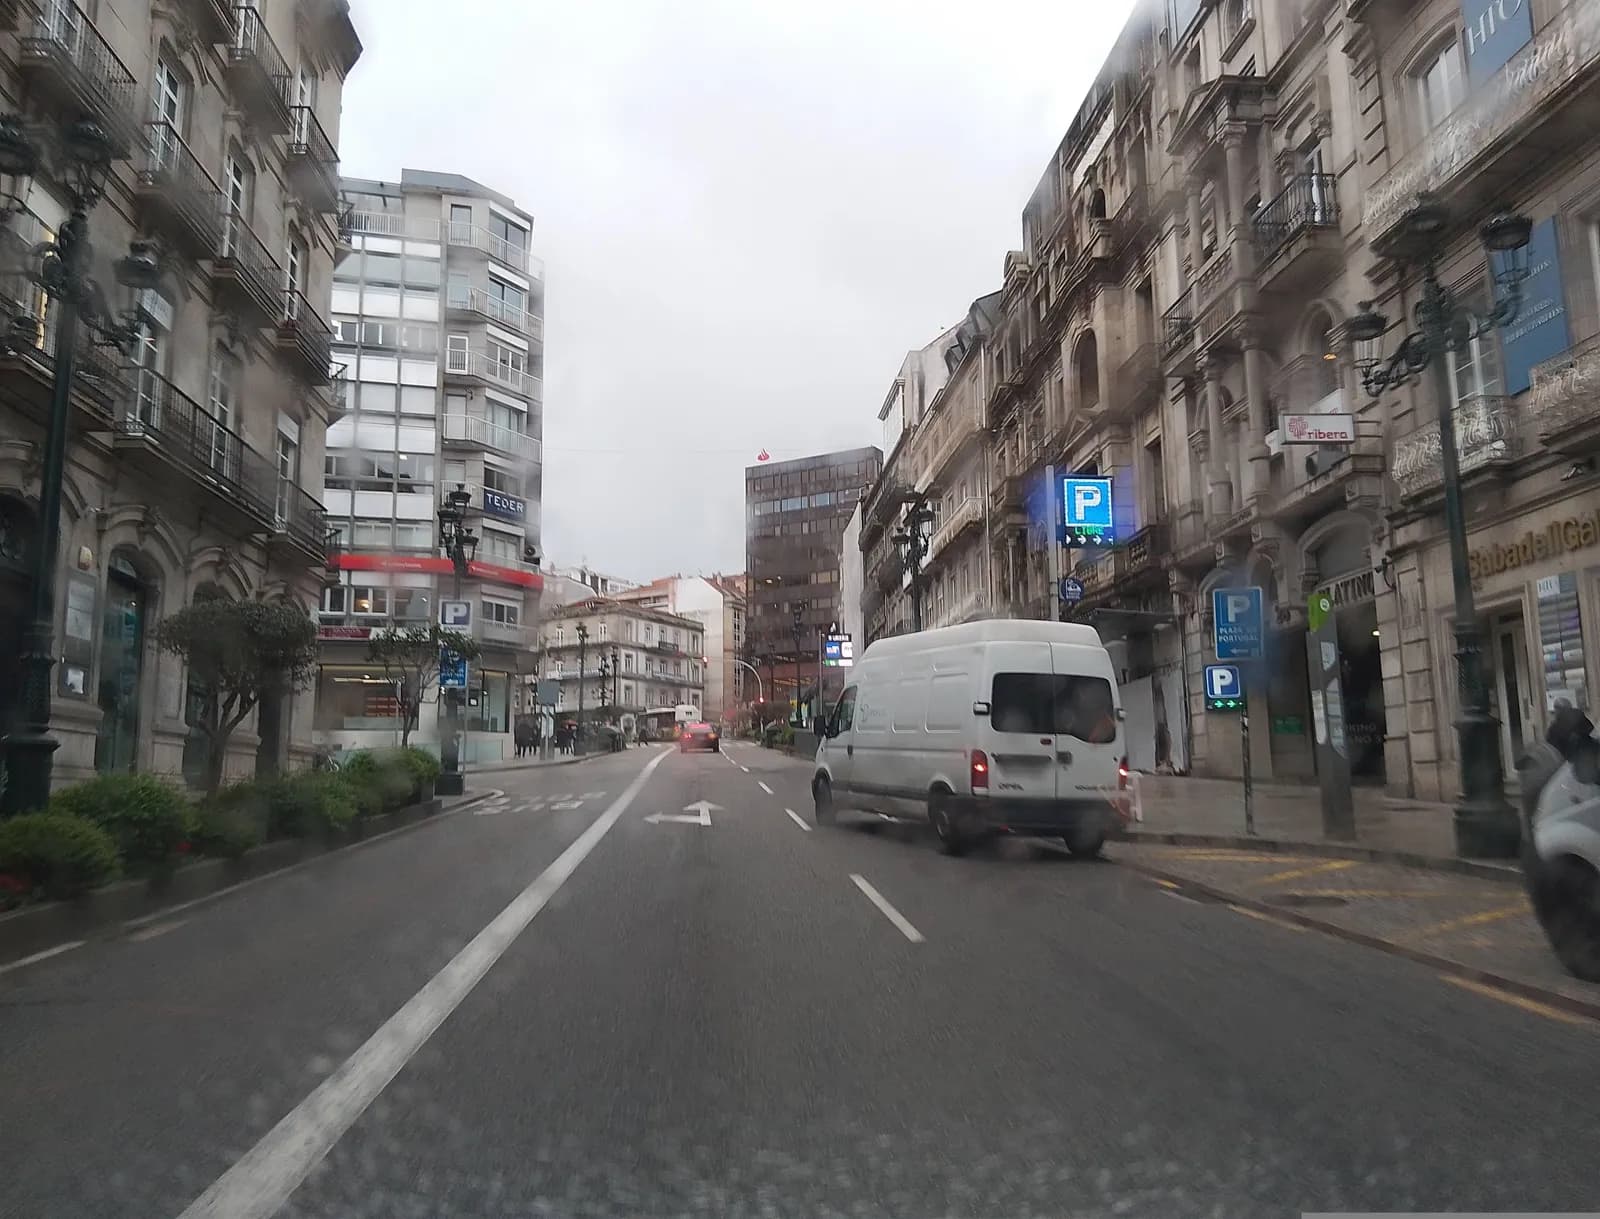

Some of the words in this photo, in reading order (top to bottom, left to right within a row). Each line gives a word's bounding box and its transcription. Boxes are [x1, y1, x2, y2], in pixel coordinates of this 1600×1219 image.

[1307, 429, 1348, 440] ribera
[1075, 486, 1101, 521] P
[445, 603, 467, 624] P
[1227, 595, 1250, 623] P
[1212, 668, 1233, 696] P
